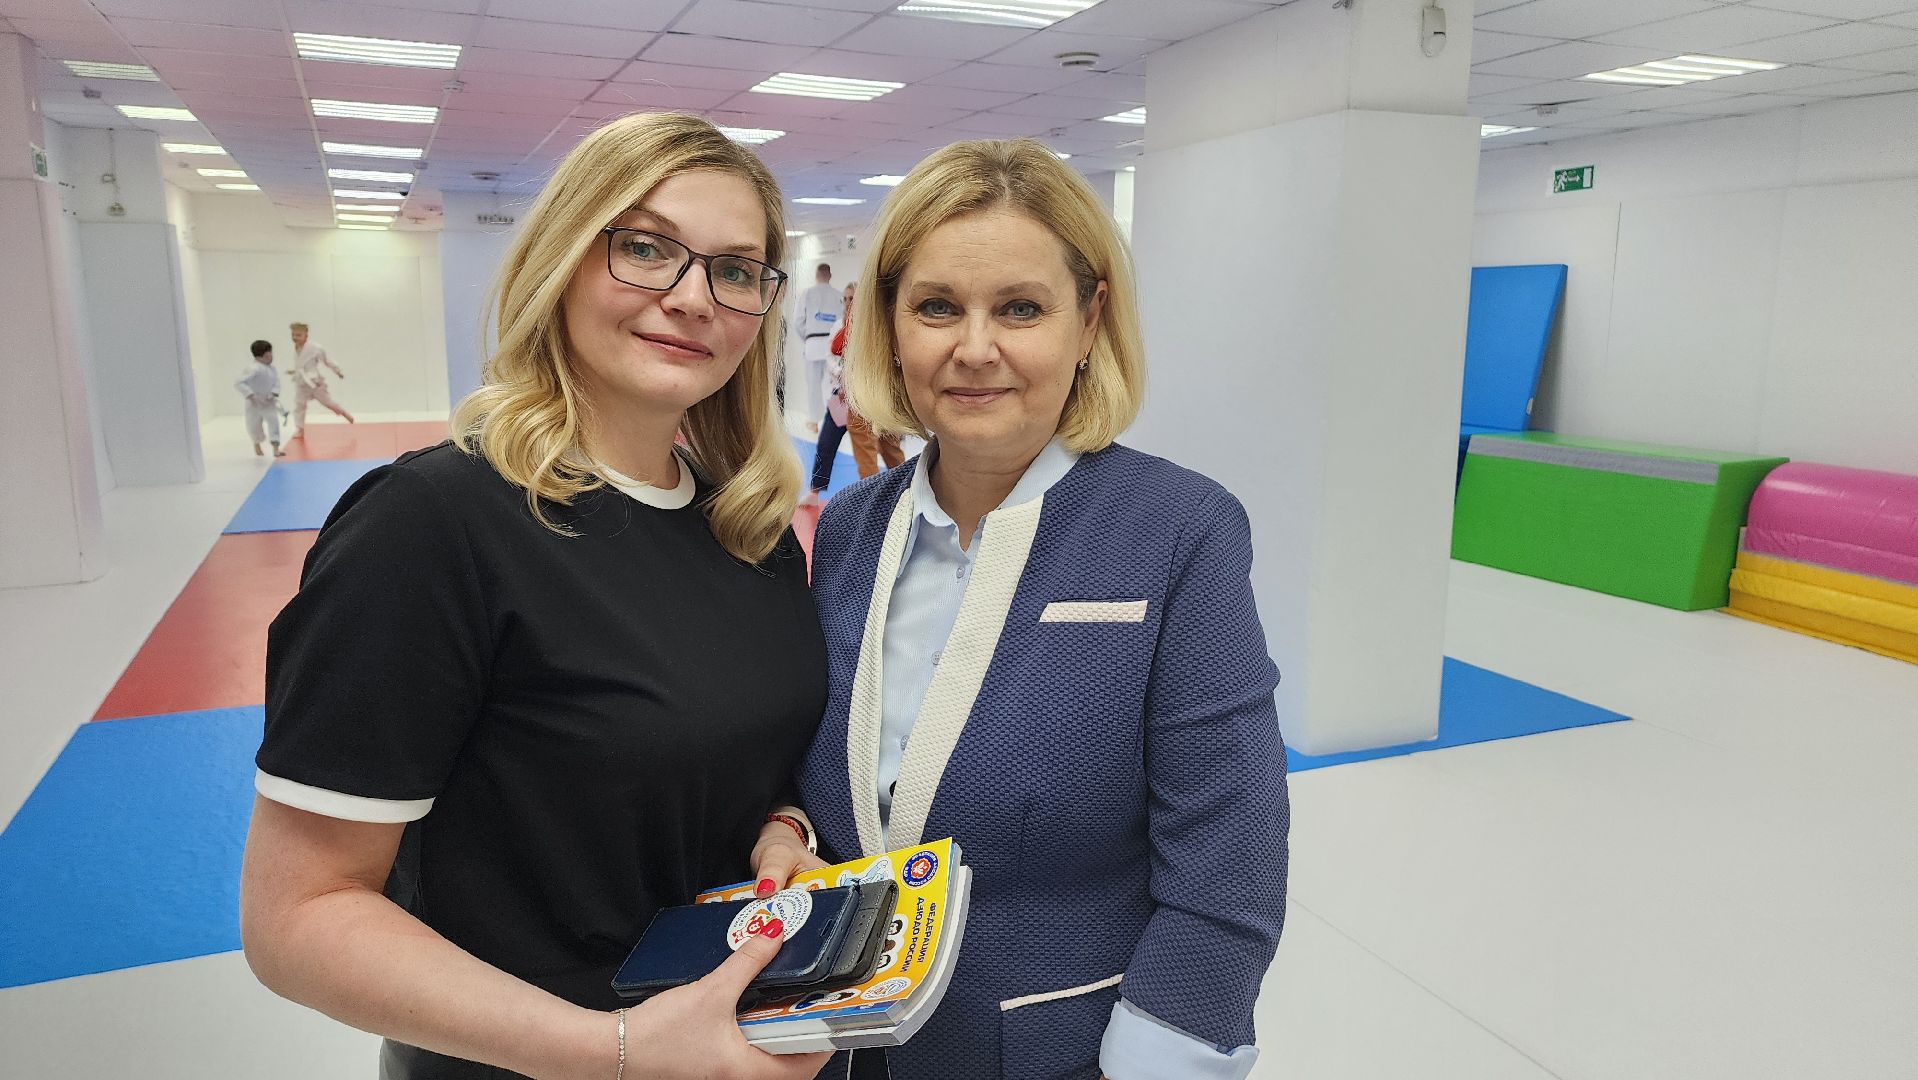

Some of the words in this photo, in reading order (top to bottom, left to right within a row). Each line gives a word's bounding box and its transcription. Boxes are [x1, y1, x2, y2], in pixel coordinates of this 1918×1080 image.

[912, 896, 925, 935] ДЗЮДО
[917, 902, 937, 963] ФЕДЕРАЦИЯ
[900, 937, 918, 972] РОССИИ
